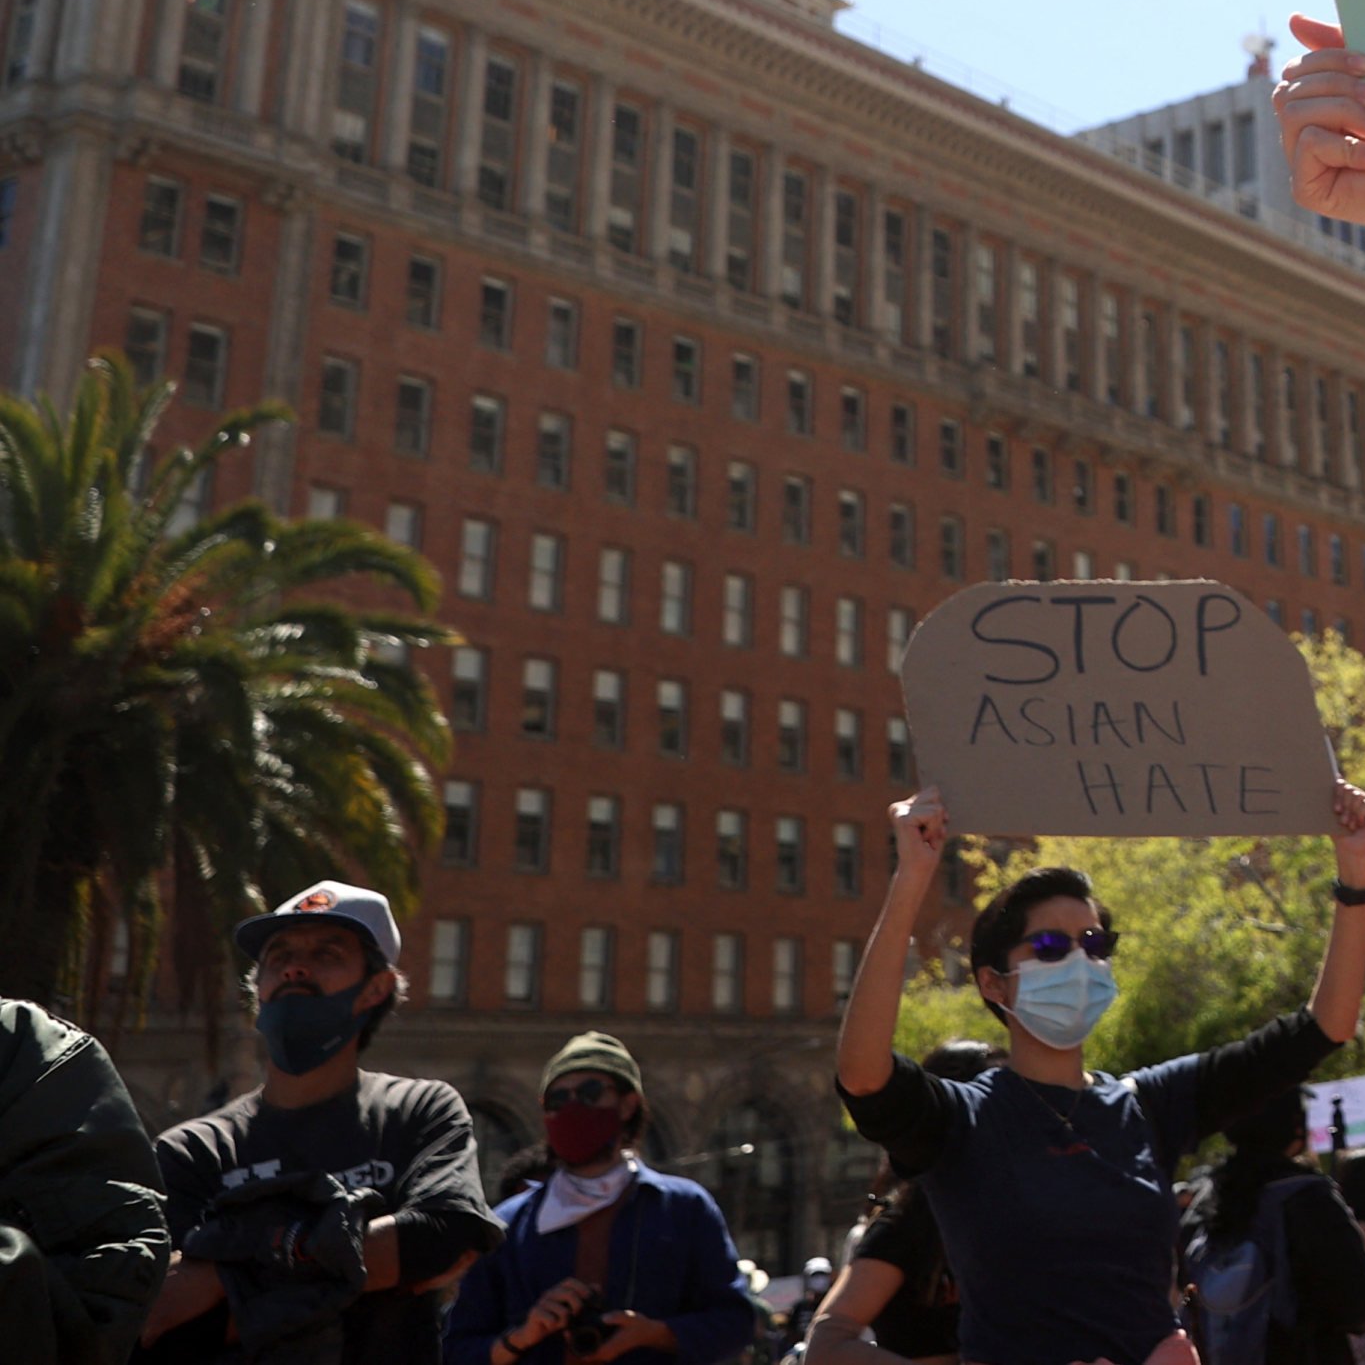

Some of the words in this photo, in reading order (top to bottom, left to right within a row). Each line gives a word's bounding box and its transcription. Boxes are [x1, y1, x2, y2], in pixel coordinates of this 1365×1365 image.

[971, 593, 1242, 686] STOP
[969, 693, 1187, 748] ASIAN
[1076, 759, 1282, 816] HATE
